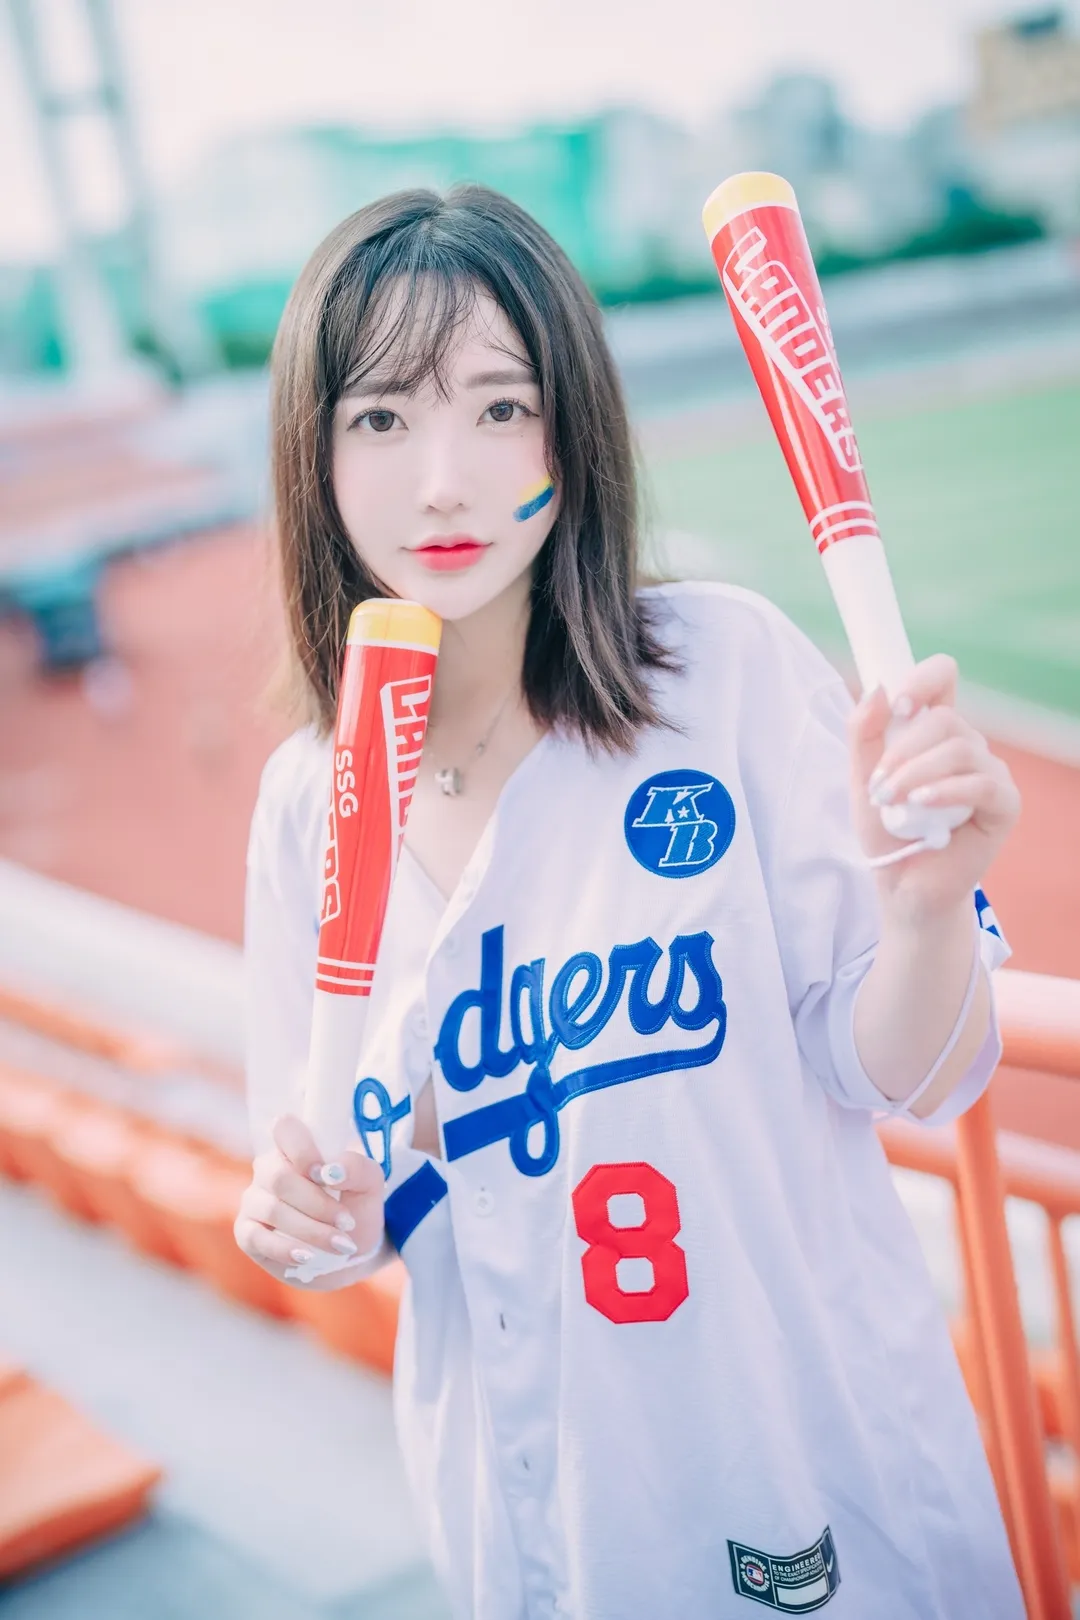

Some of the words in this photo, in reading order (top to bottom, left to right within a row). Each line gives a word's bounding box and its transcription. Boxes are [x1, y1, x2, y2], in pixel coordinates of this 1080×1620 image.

[722, 226, 864, 473] LANDERS
[335, 748, 359, 819] SSG
[631, 781, 718, 868] KB
[571, 1161, 690, 1325] 8
